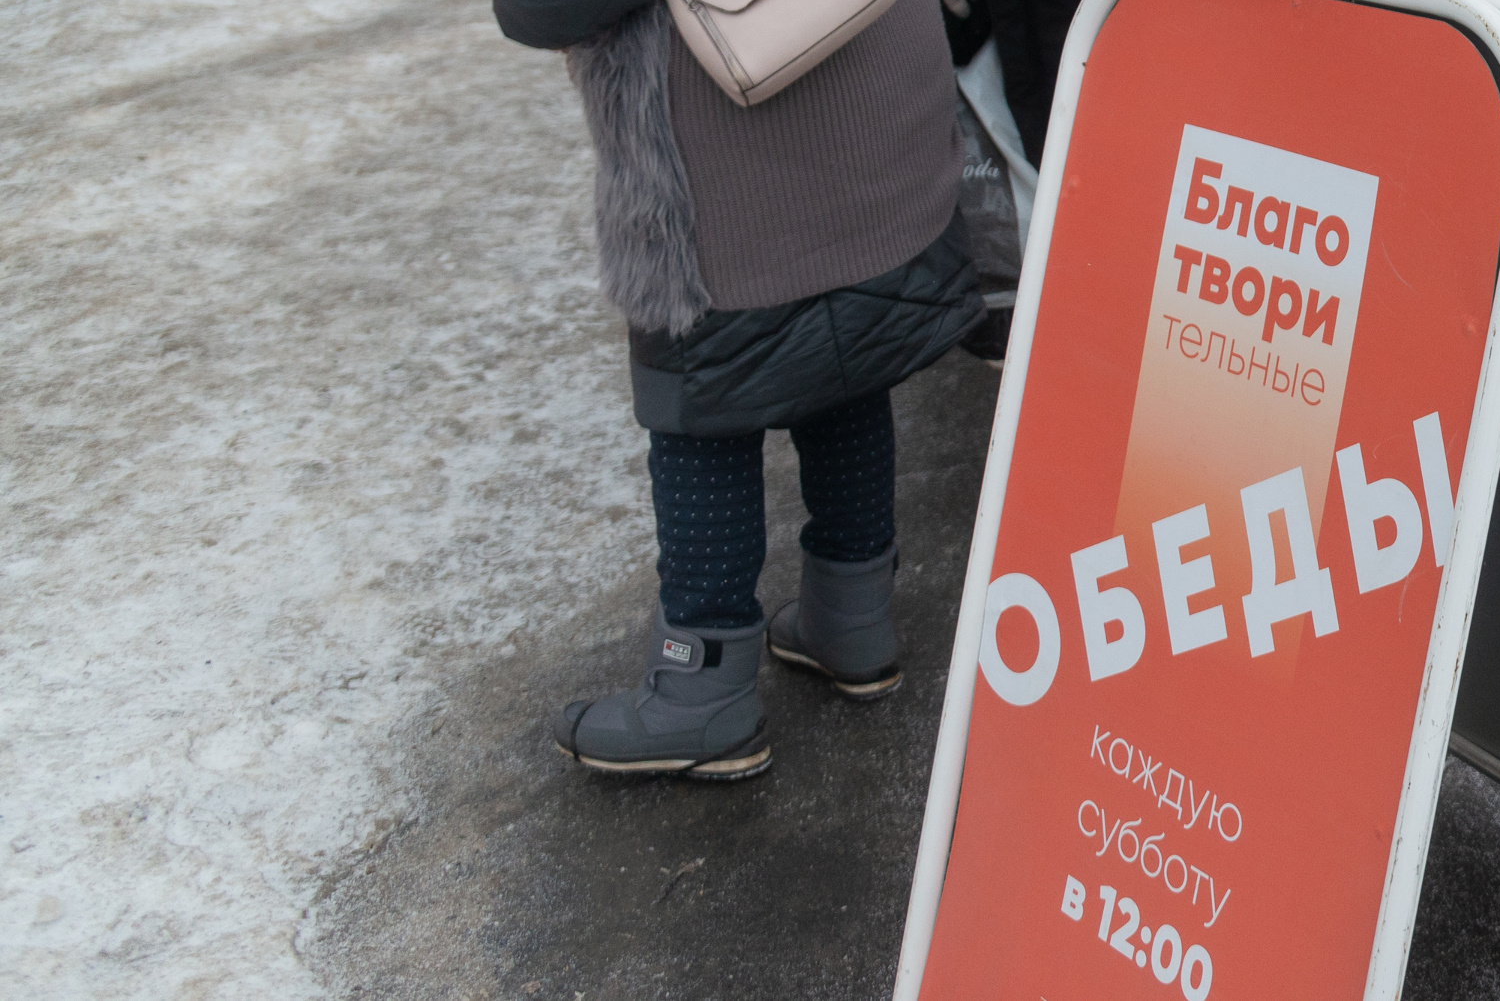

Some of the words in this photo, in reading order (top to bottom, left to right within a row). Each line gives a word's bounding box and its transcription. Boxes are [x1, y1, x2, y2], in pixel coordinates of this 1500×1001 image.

[1184, 156, 1350, 267] Благо
[1173, 243, 1340, 346] твори
[1163, 314, 1325, 406] тельные
[977, 411, 1456, 707] ОБЕДЫ
[1090, 724, 1243, 842] каждую
[1077, 799, 1231, 928] субботу
[1060, 873, 1086, 922] в
[1097, 885, 1213, 1001] 12:00
